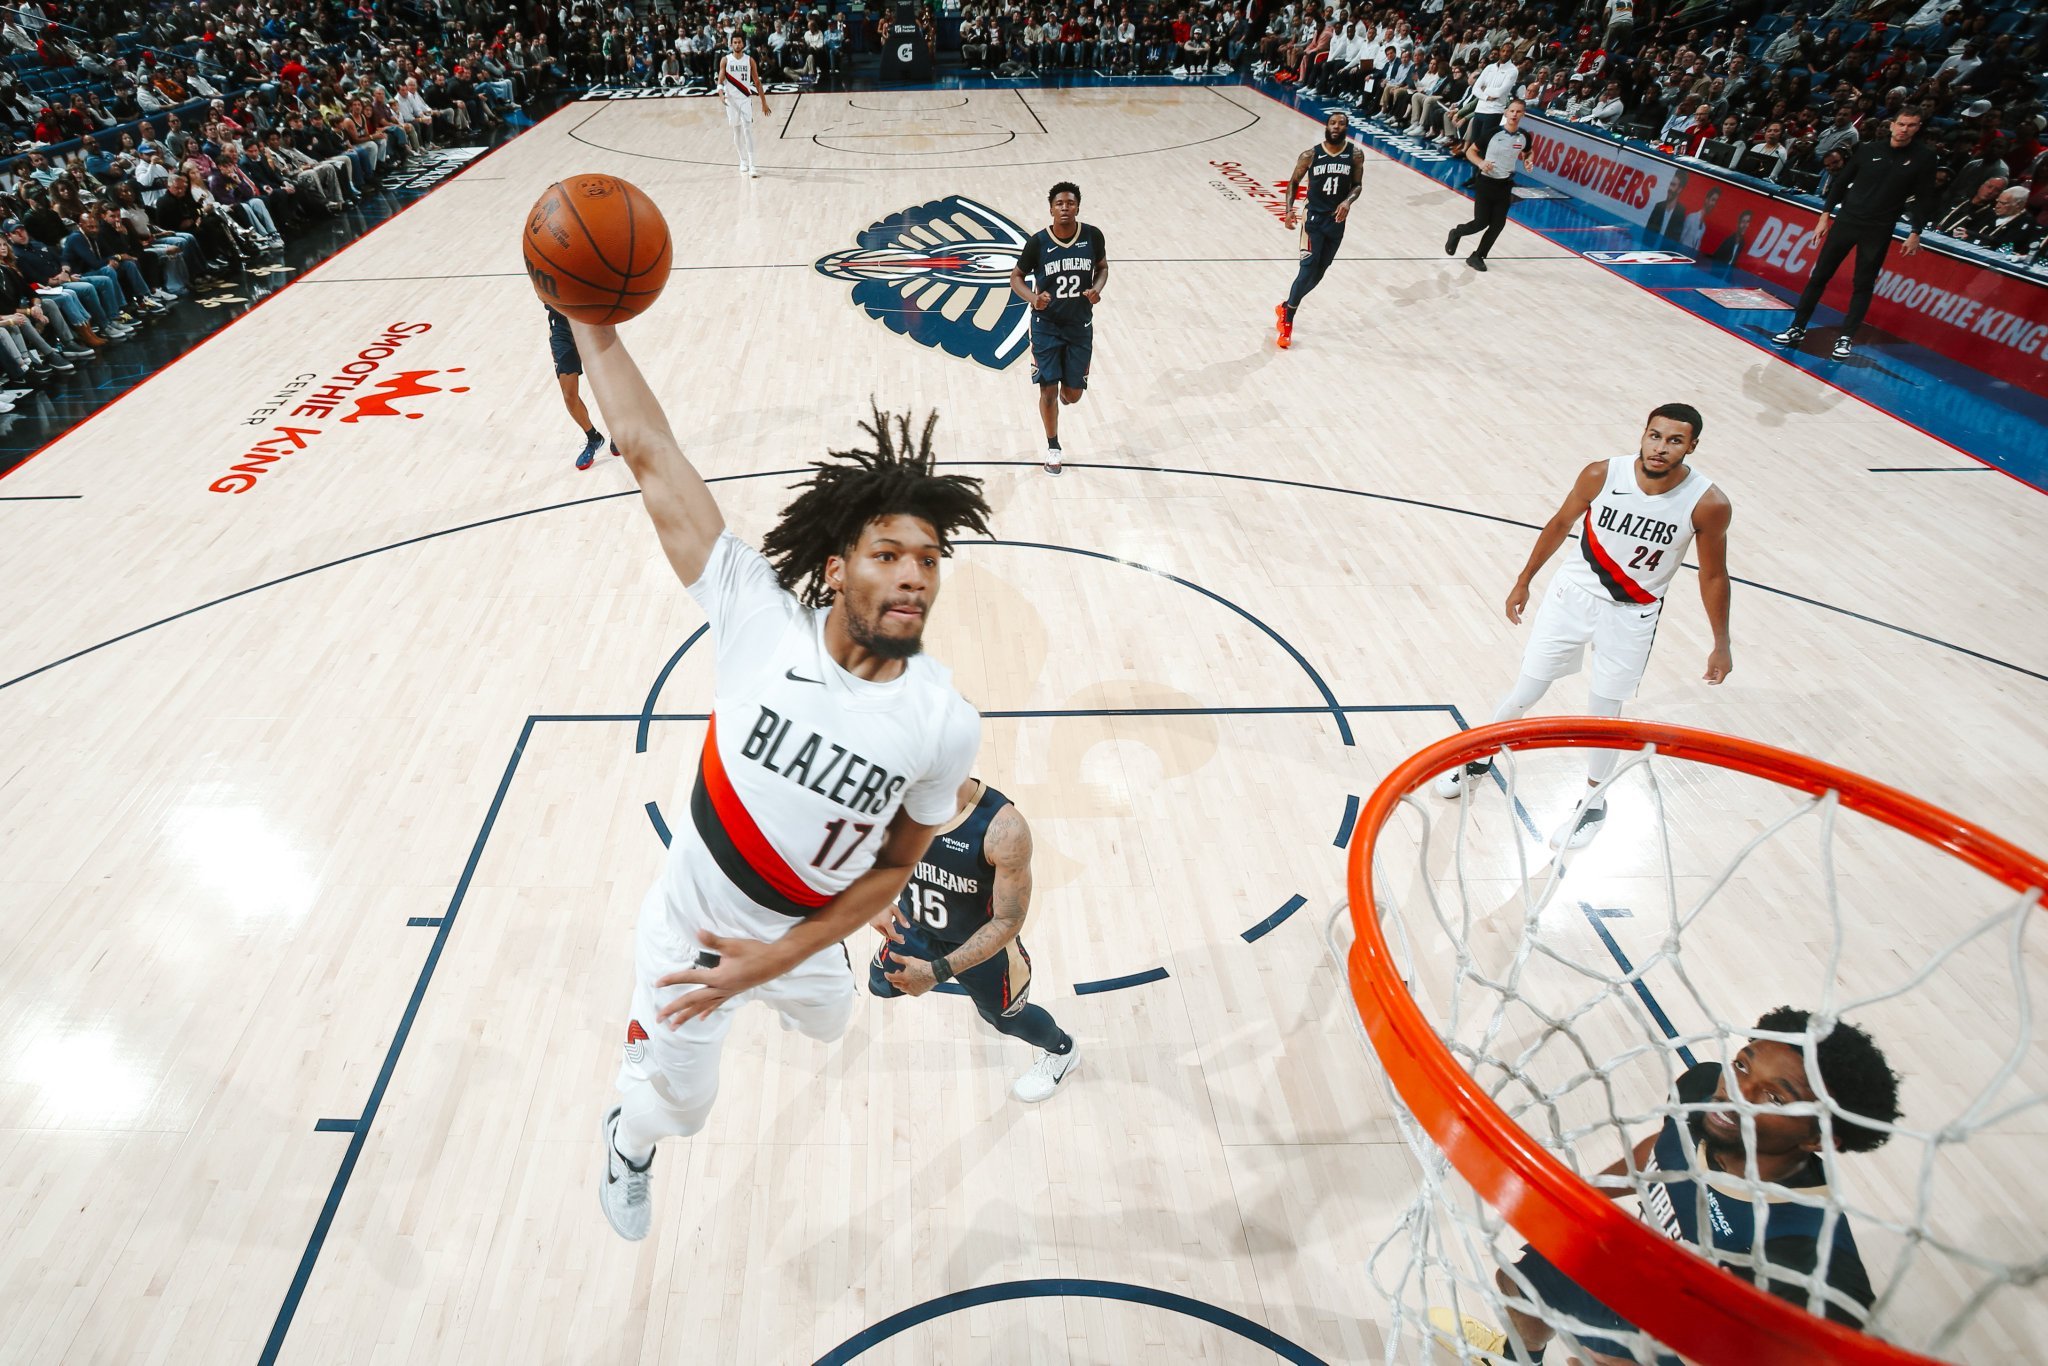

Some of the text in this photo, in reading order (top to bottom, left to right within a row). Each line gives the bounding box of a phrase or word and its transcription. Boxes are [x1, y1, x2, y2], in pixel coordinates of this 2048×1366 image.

[897, 43, 913, 62] G
[1209, 160, 1277, 199] SMOOTHIE
[1313, 163, 1351, 176] NEW ORLEANS
[1322, 176, 1339, 196] 41
[1557, 143, 1658, 210] BROTHERS
[1209, 180, 1242, 201] CENTER
[1747, 216, 1820, 273] DEC
[1044, 257, 1092, 277] NEW ORLEANS
[1056, 275, 1081, 299] 22
[1873, 267, 2048, 355] MOOTHIE KING
[289, 321, 433, 419] SMOOTHIE
[240, 372, 317, 426] CENTER
[1597, 505, 1678, 545] BLAZERS
[1627, 545, 1665, 572] 24
[741, 704, 906, 816] BLAZERS
[810, 818, 874, 871] 17
[942, 836, 970, 850] NEWAGE
[946, 844, 964, 853] GARAGE
[914, 861, 978, 894] ORLEANS
[908, 882, 948, 929] 15
[1707, 1191, 1733, 1237] NEWAGE
